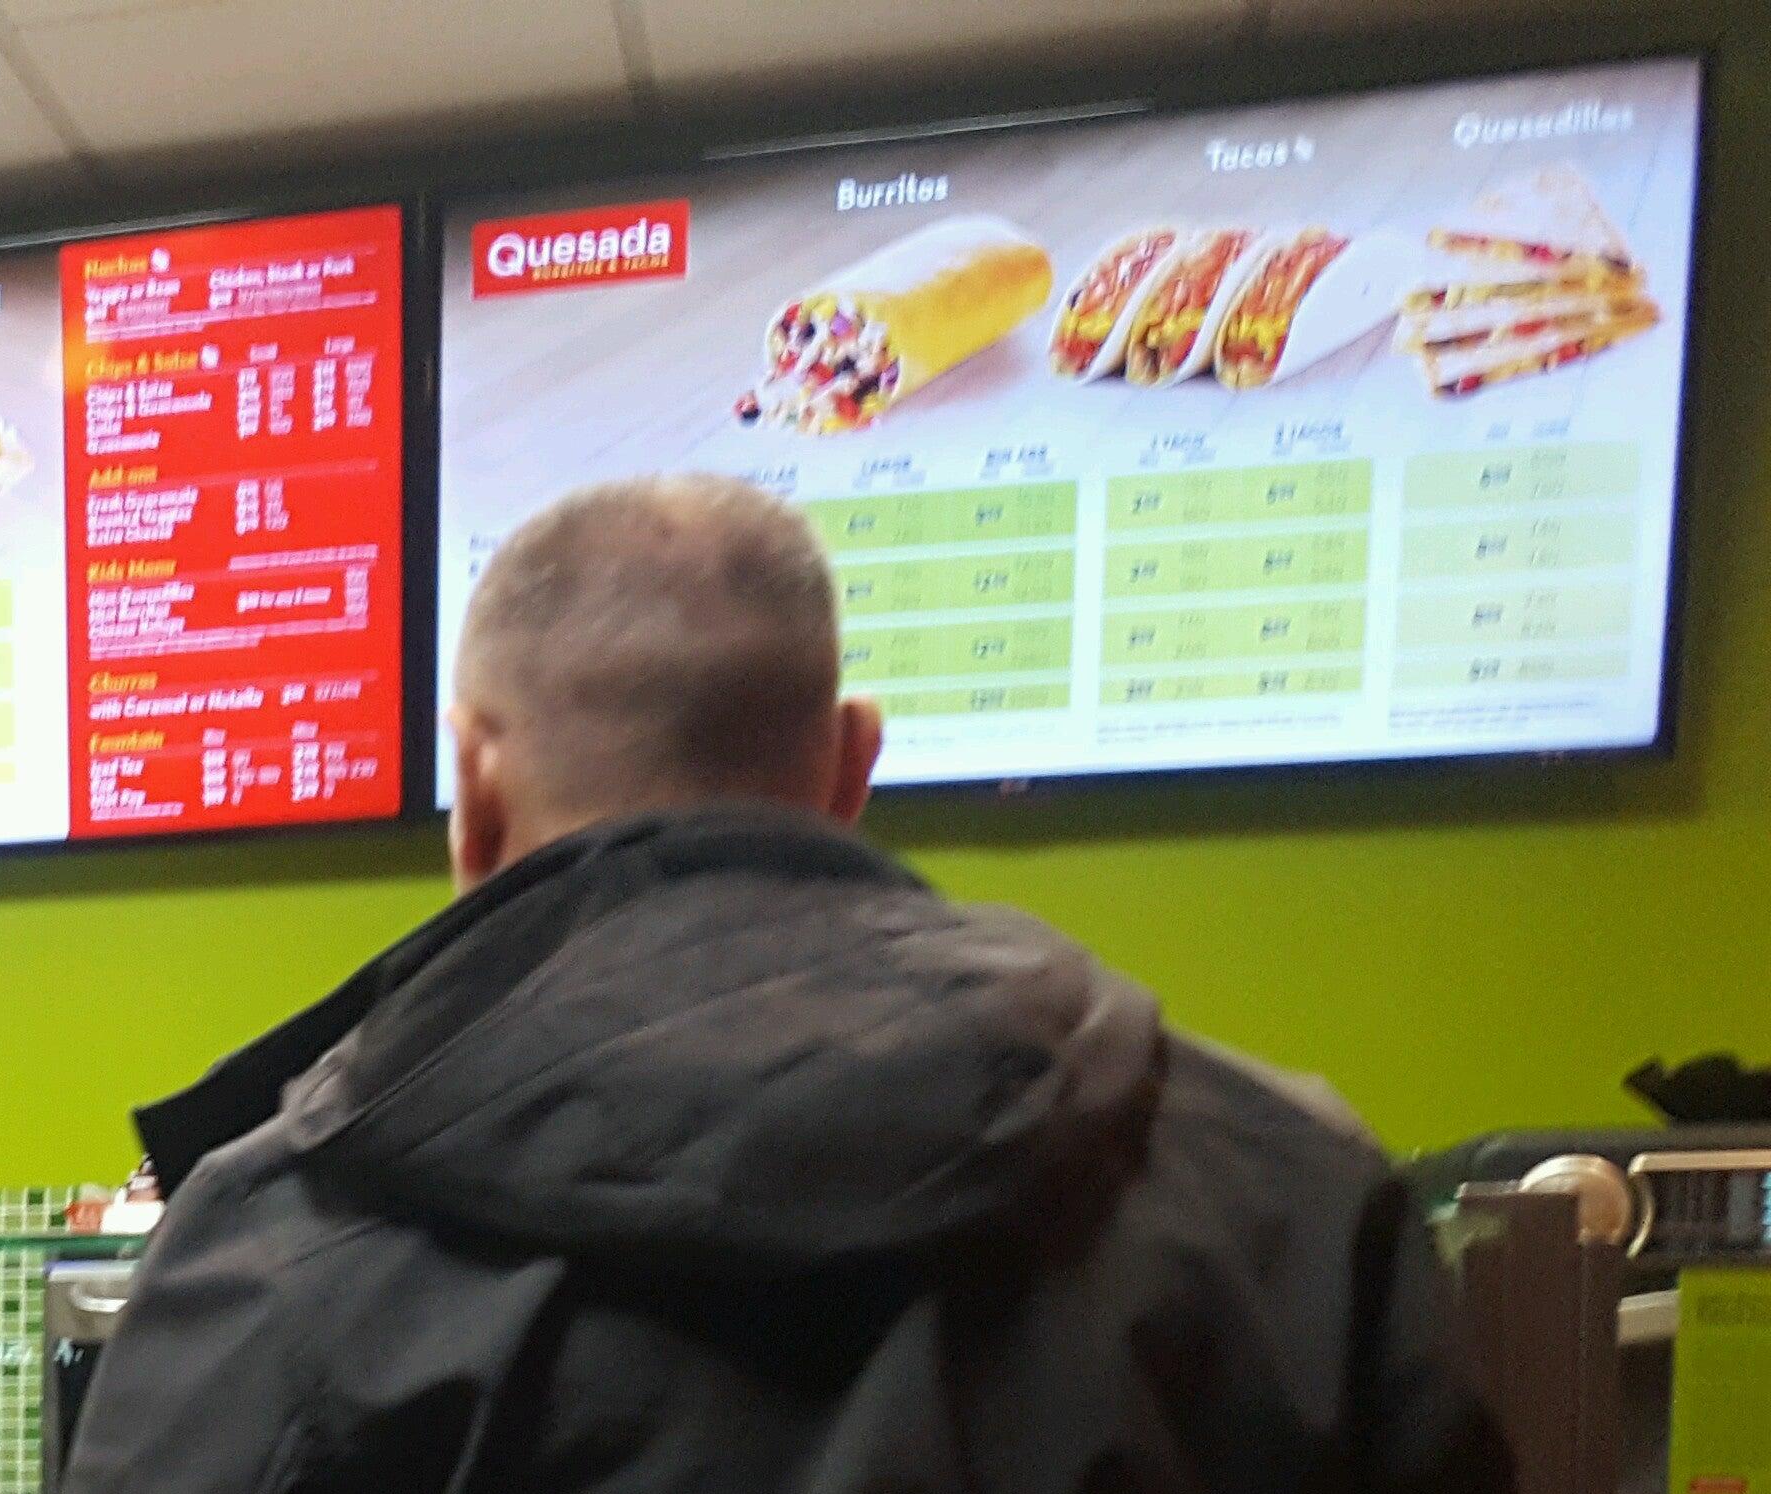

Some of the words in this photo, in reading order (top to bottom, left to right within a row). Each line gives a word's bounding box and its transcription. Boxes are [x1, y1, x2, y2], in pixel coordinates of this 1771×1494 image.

[1454, 100, 1634, 148] Quesadillas
[1206, 137, 1289, 172] Tacos
[837, 171, 948, 211] Burritos
[488, 217, 672, 277] Quesada
